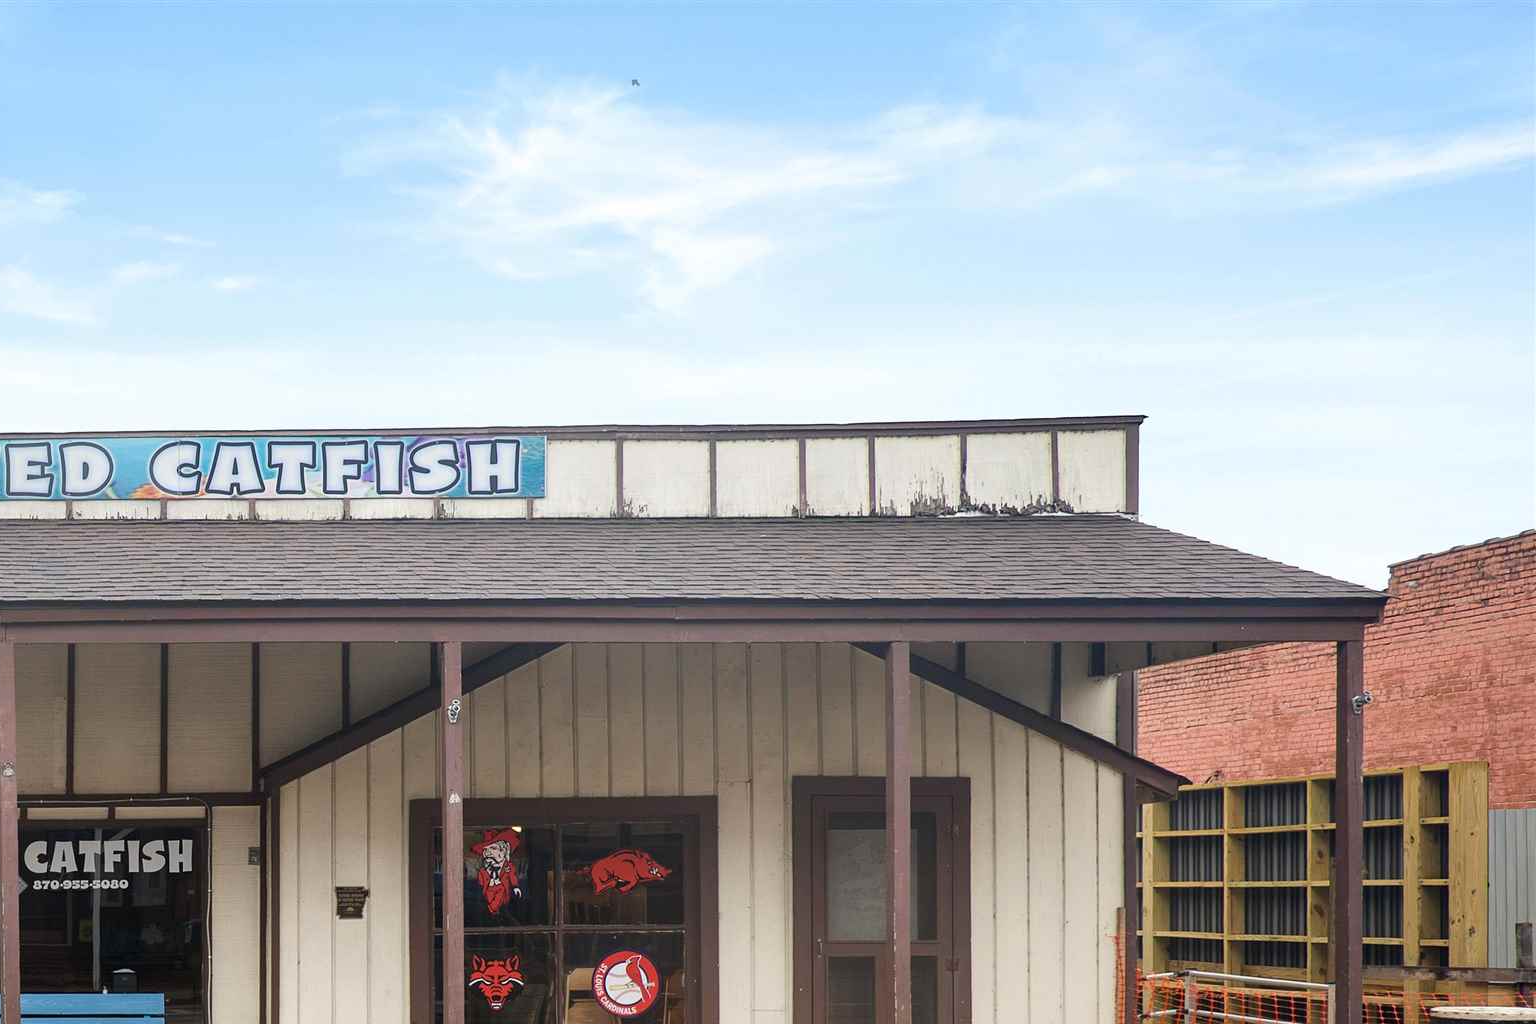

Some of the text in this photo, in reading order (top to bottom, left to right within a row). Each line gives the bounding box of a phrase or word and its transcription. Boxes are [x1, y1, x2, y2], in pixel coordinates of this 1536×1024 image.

[149, 439, 521, 497] CATFISH
[24, 839, 193, 873] CATFISH
[595, 974, 604, 995] LOUIS
[600, 997, 637, 1015] CARDINALS
